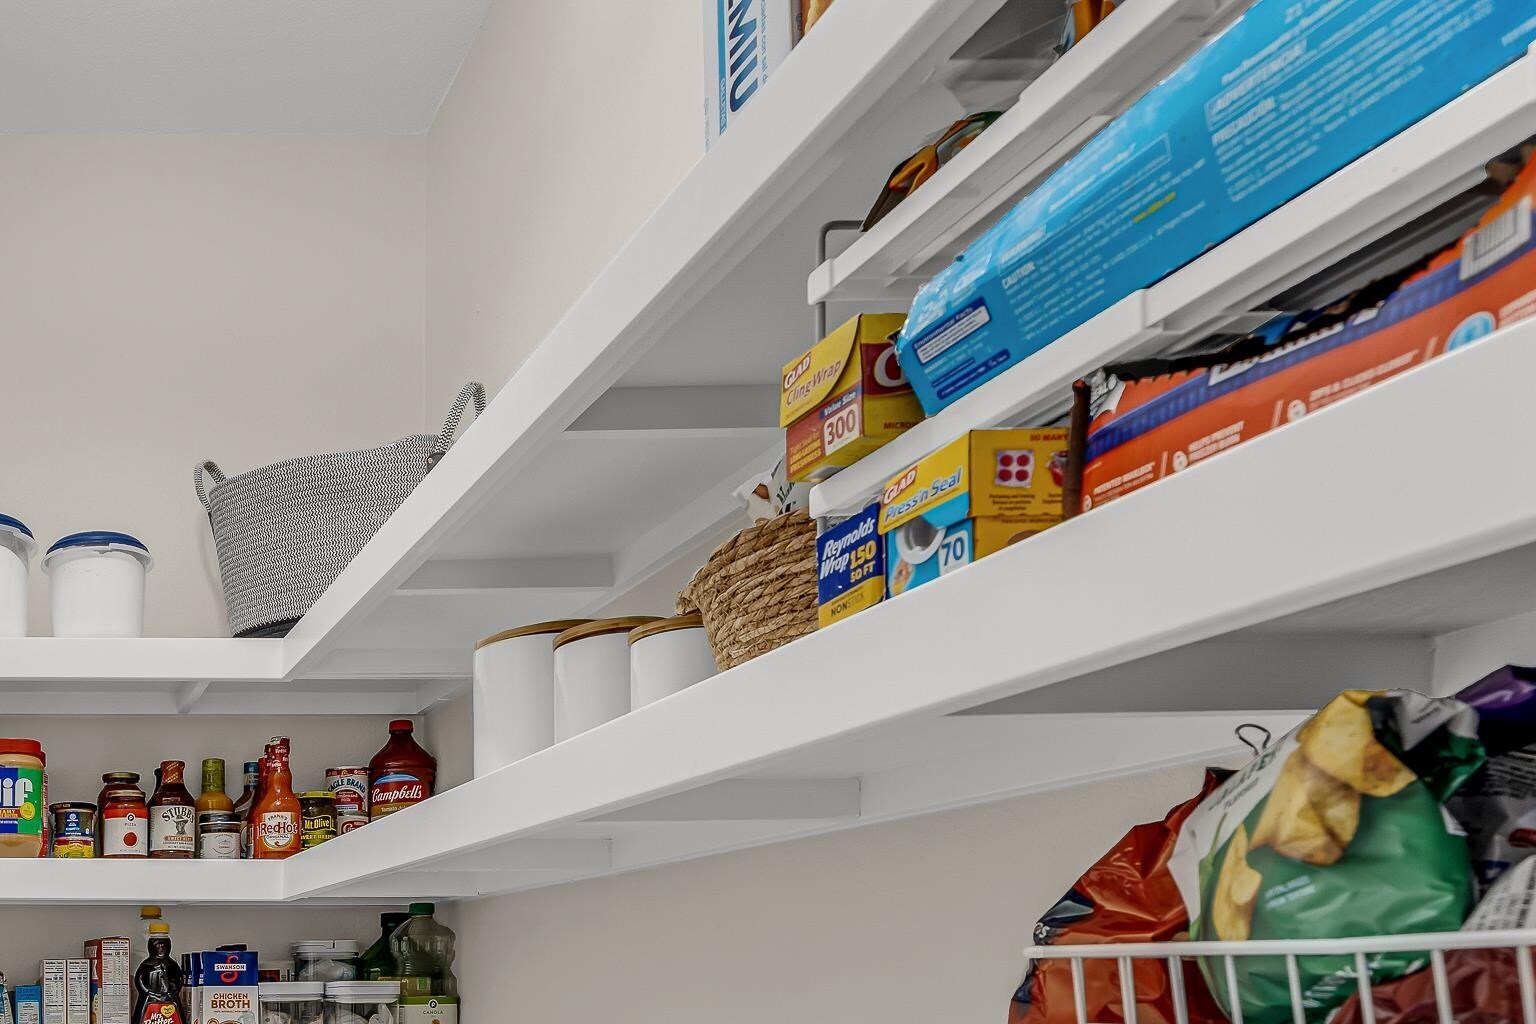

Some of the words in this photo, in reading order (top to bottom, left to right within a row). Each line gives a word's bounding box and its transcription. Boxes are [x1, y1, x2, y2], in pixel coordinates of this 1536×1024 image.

[784, 354, 811, 388] GLAD
[786, 381, 811, 406] Cling
[812, 361, 841, 389] Wrap
[842, 391, 857, 406] Size
[827, 409, 857, 446] 300
[884, 469, 915, 504] GLAD
[932, 466, 962, 498] Seal
[822, 517, 875, 562] Reynolds
[941, 537, 966, 567] 70
[820, 551, 850, 581] Wrap
[850, 540, 877, 570] 150
[850, 567, 863, 584] SQ
[863, 560, 877, 576] FT
[830, 592, 865, 617] NONSTICK
[372, 785, 422, 803] Campbell's
[260, 821, 298, 836] RedHot
[211, 1000, 250, 1009] BROTH
